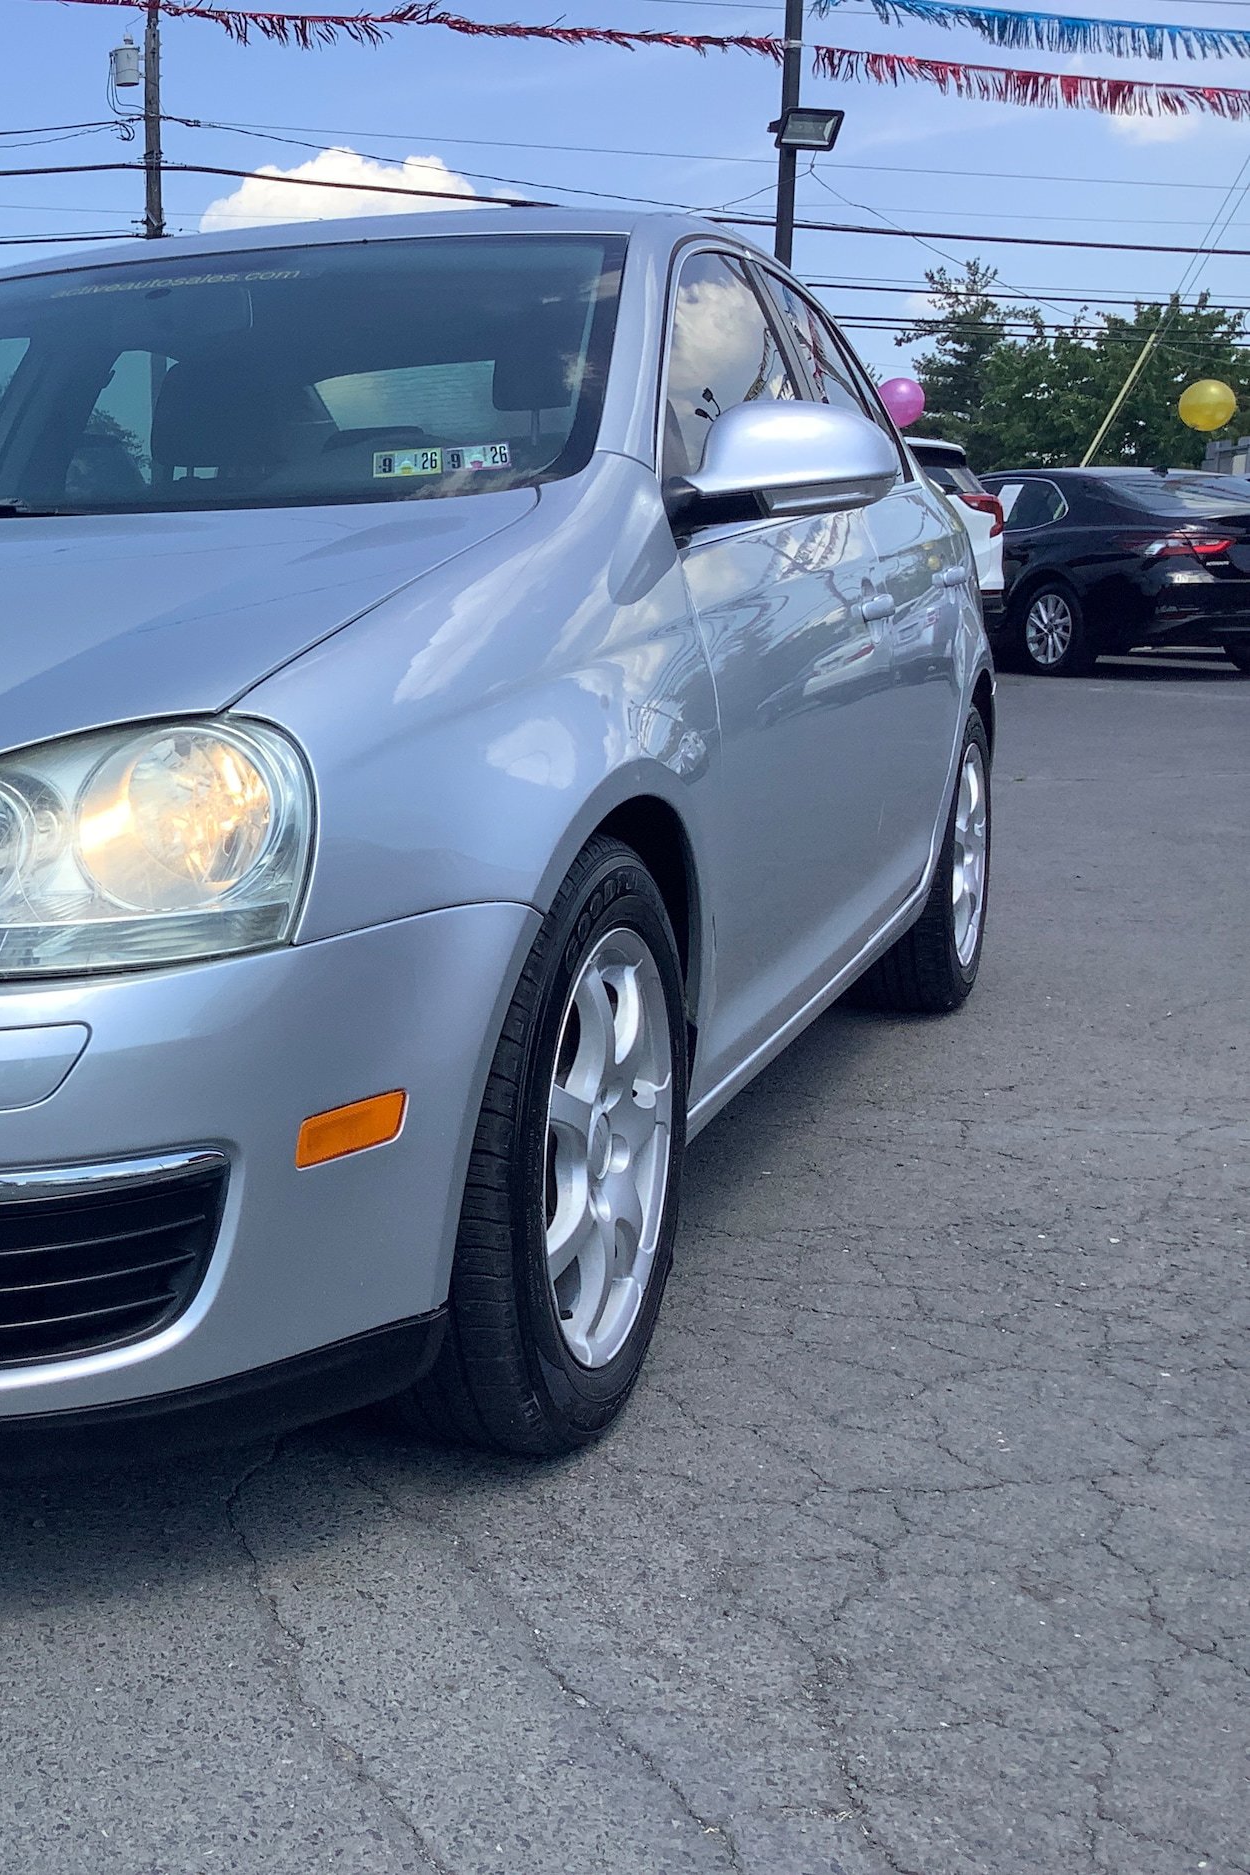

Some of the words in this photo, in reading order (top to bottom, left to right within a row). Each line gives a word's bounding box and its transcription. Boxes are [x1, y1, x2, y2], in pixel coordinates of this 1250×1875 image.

[382, 457, 392, 473] 9
[421, 451, 438, 470] 26
[450, 453, 461, 469] 9
[490, 445, 508, 464] 26
